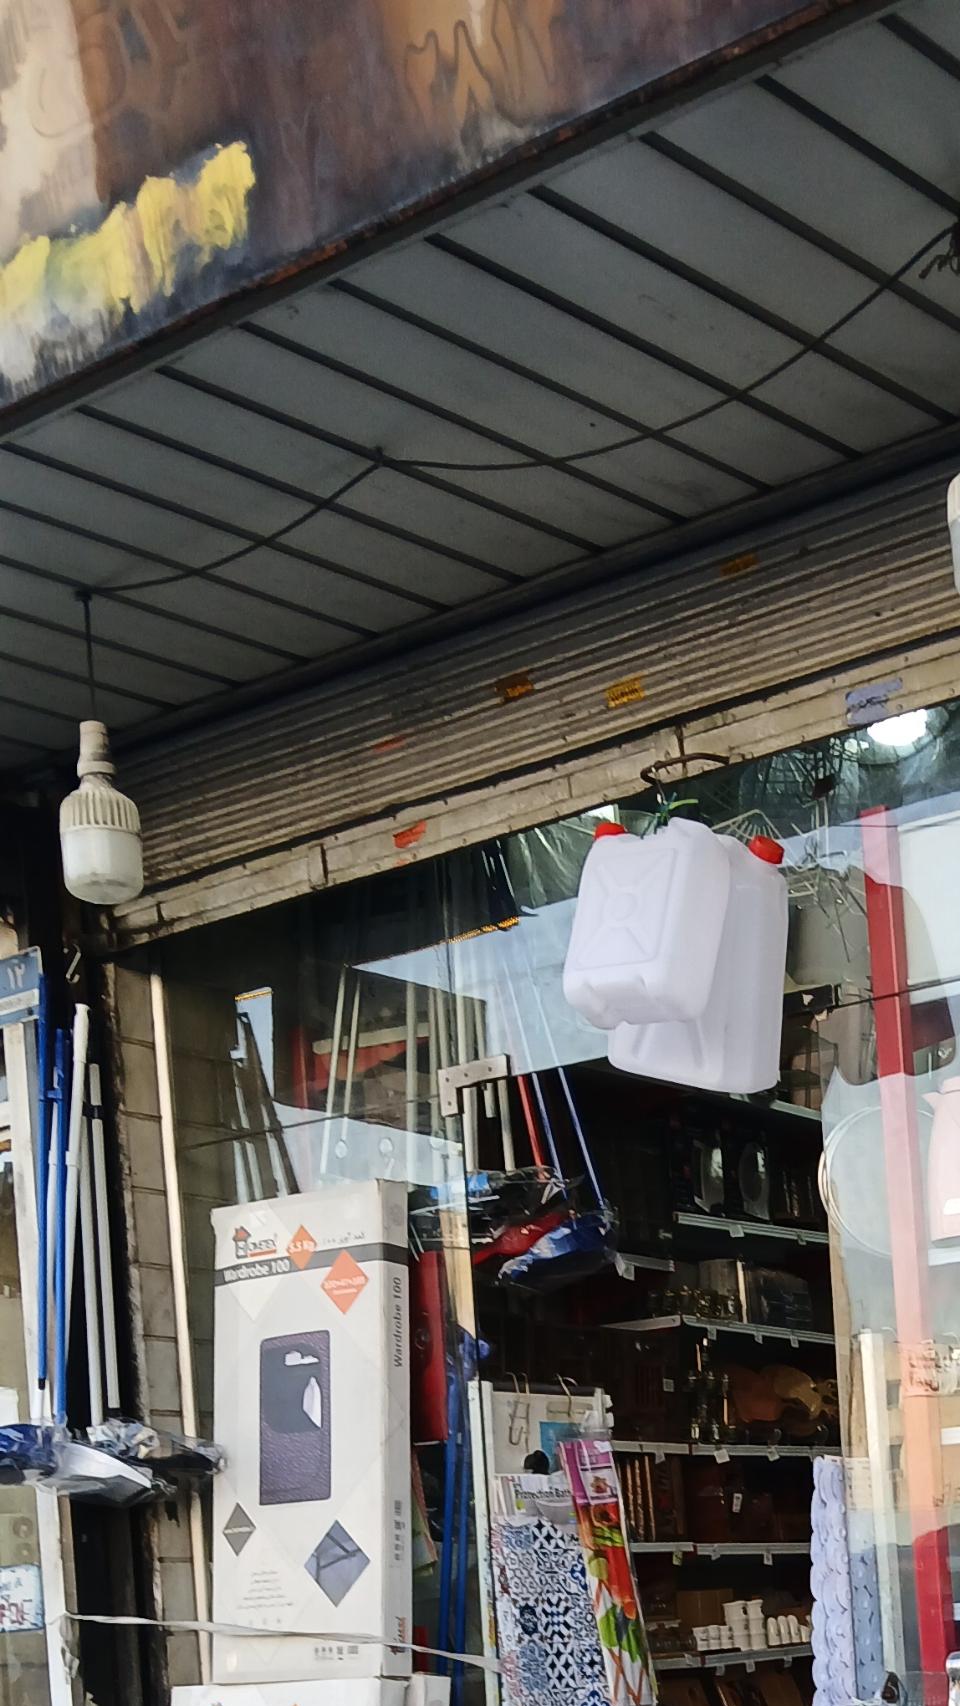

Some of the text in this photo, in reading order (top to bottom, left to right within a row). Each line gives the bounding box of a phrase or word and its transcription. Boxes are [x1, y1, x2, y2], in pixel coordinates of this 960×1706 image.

[223, 1258, 291, 1282] Wardrobe 100
[393, 1276, 403, 1367] Wardrobe 100
